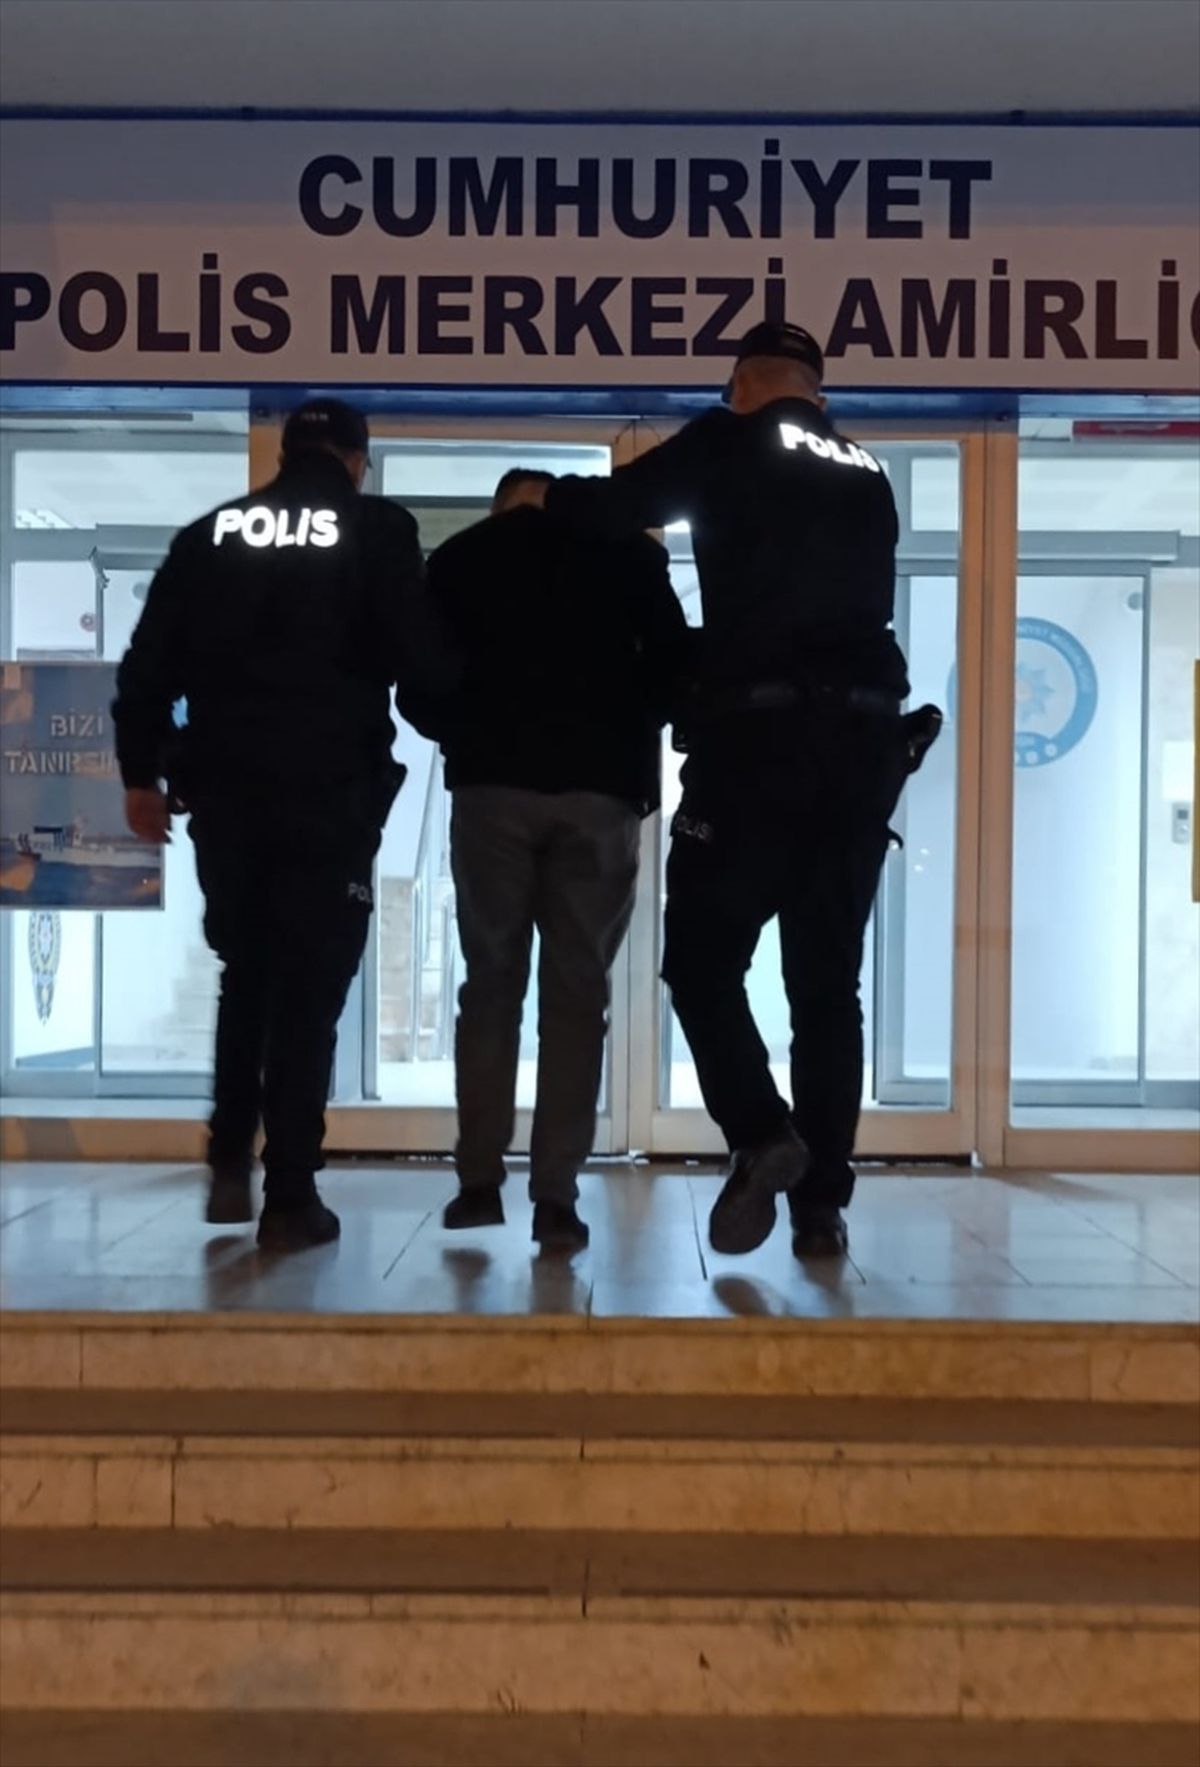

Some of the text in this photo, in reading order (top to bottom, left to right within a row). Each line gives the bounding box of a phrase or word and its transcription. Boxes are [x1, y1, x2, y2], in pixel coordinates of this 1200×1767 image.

[299, 138, 992, 240] CUMHURİYET
[0, 252, 1200, 360] POLİS MERKEZİ AMİRLİ
